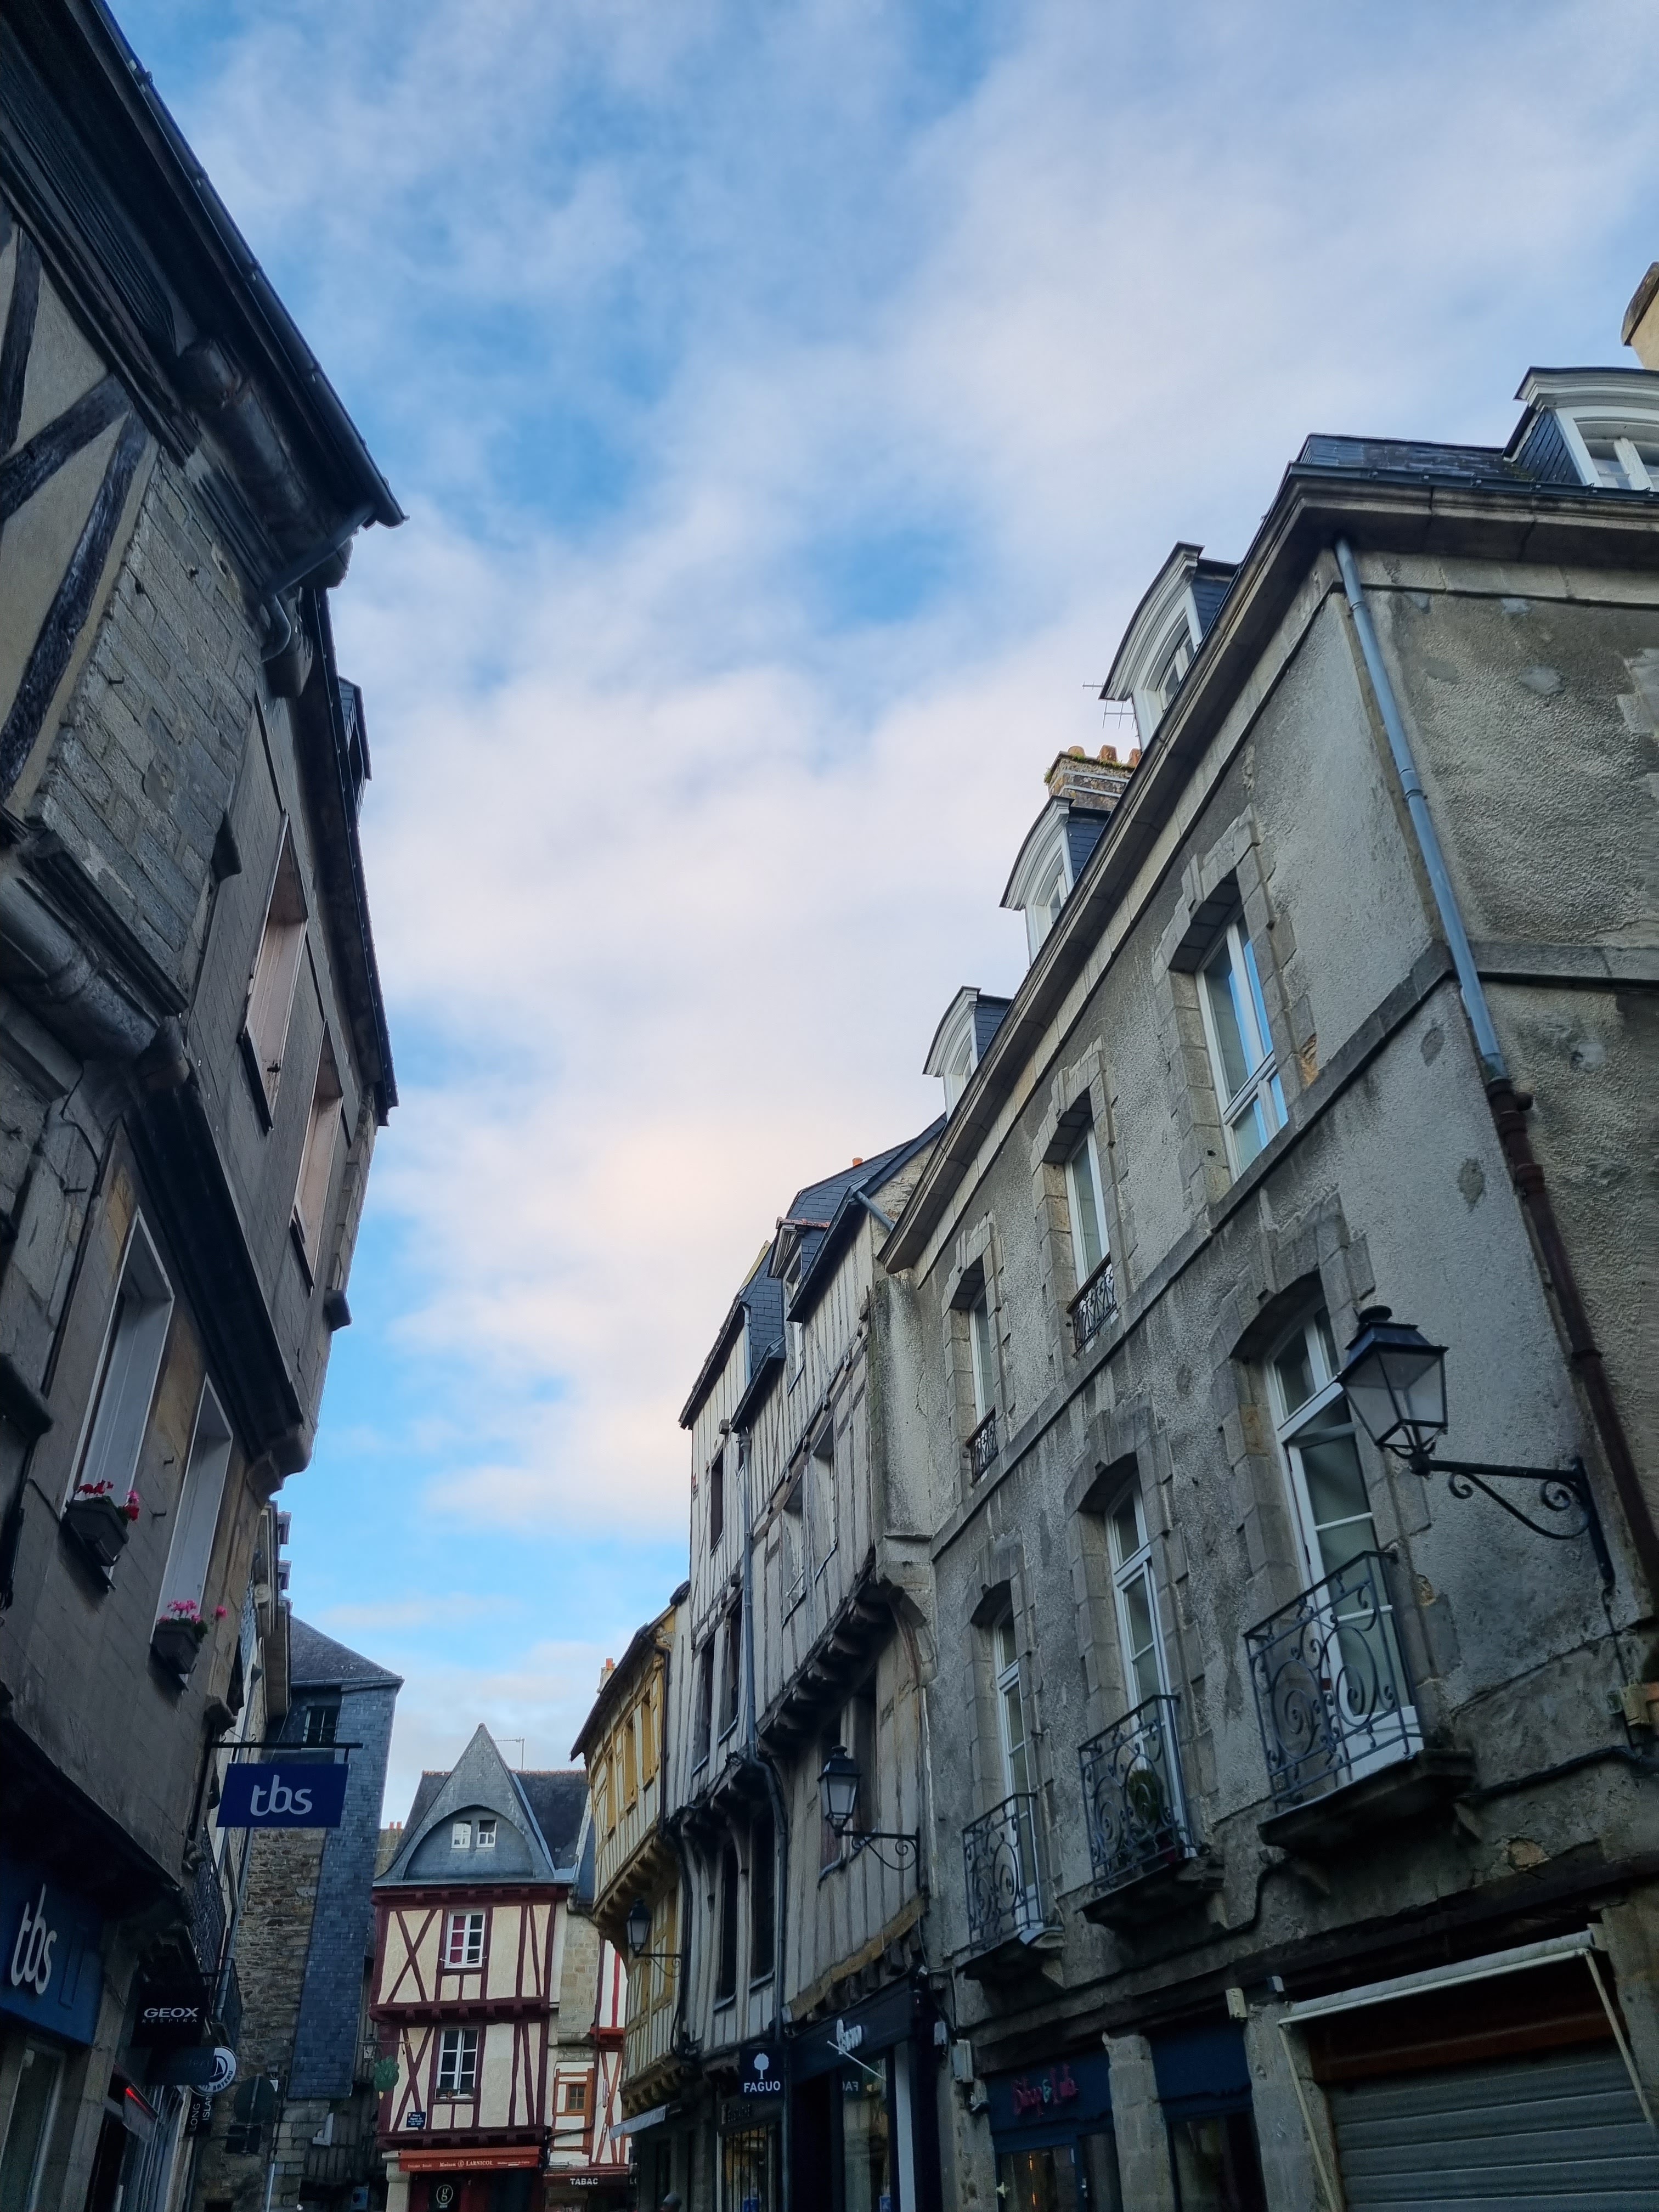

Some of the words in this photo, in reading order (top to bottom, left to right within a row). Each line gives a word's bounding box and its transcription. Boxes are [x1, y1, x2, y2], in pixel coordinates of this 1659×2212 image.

[250, 1774, 313, 1816] tbs
[11, 1882, 58, 1995] tbs
[144, 2007, 199, 2018] GEOX
[212, 2070, 234, 2091] BATEAU
[744, 2081, 781, 2093] FAGUO
[189, 2103, 201, 2131] LONG
[201, 2092, 213, 2120] ISLAN
[569, 2177, 599, 2186] TABAC
